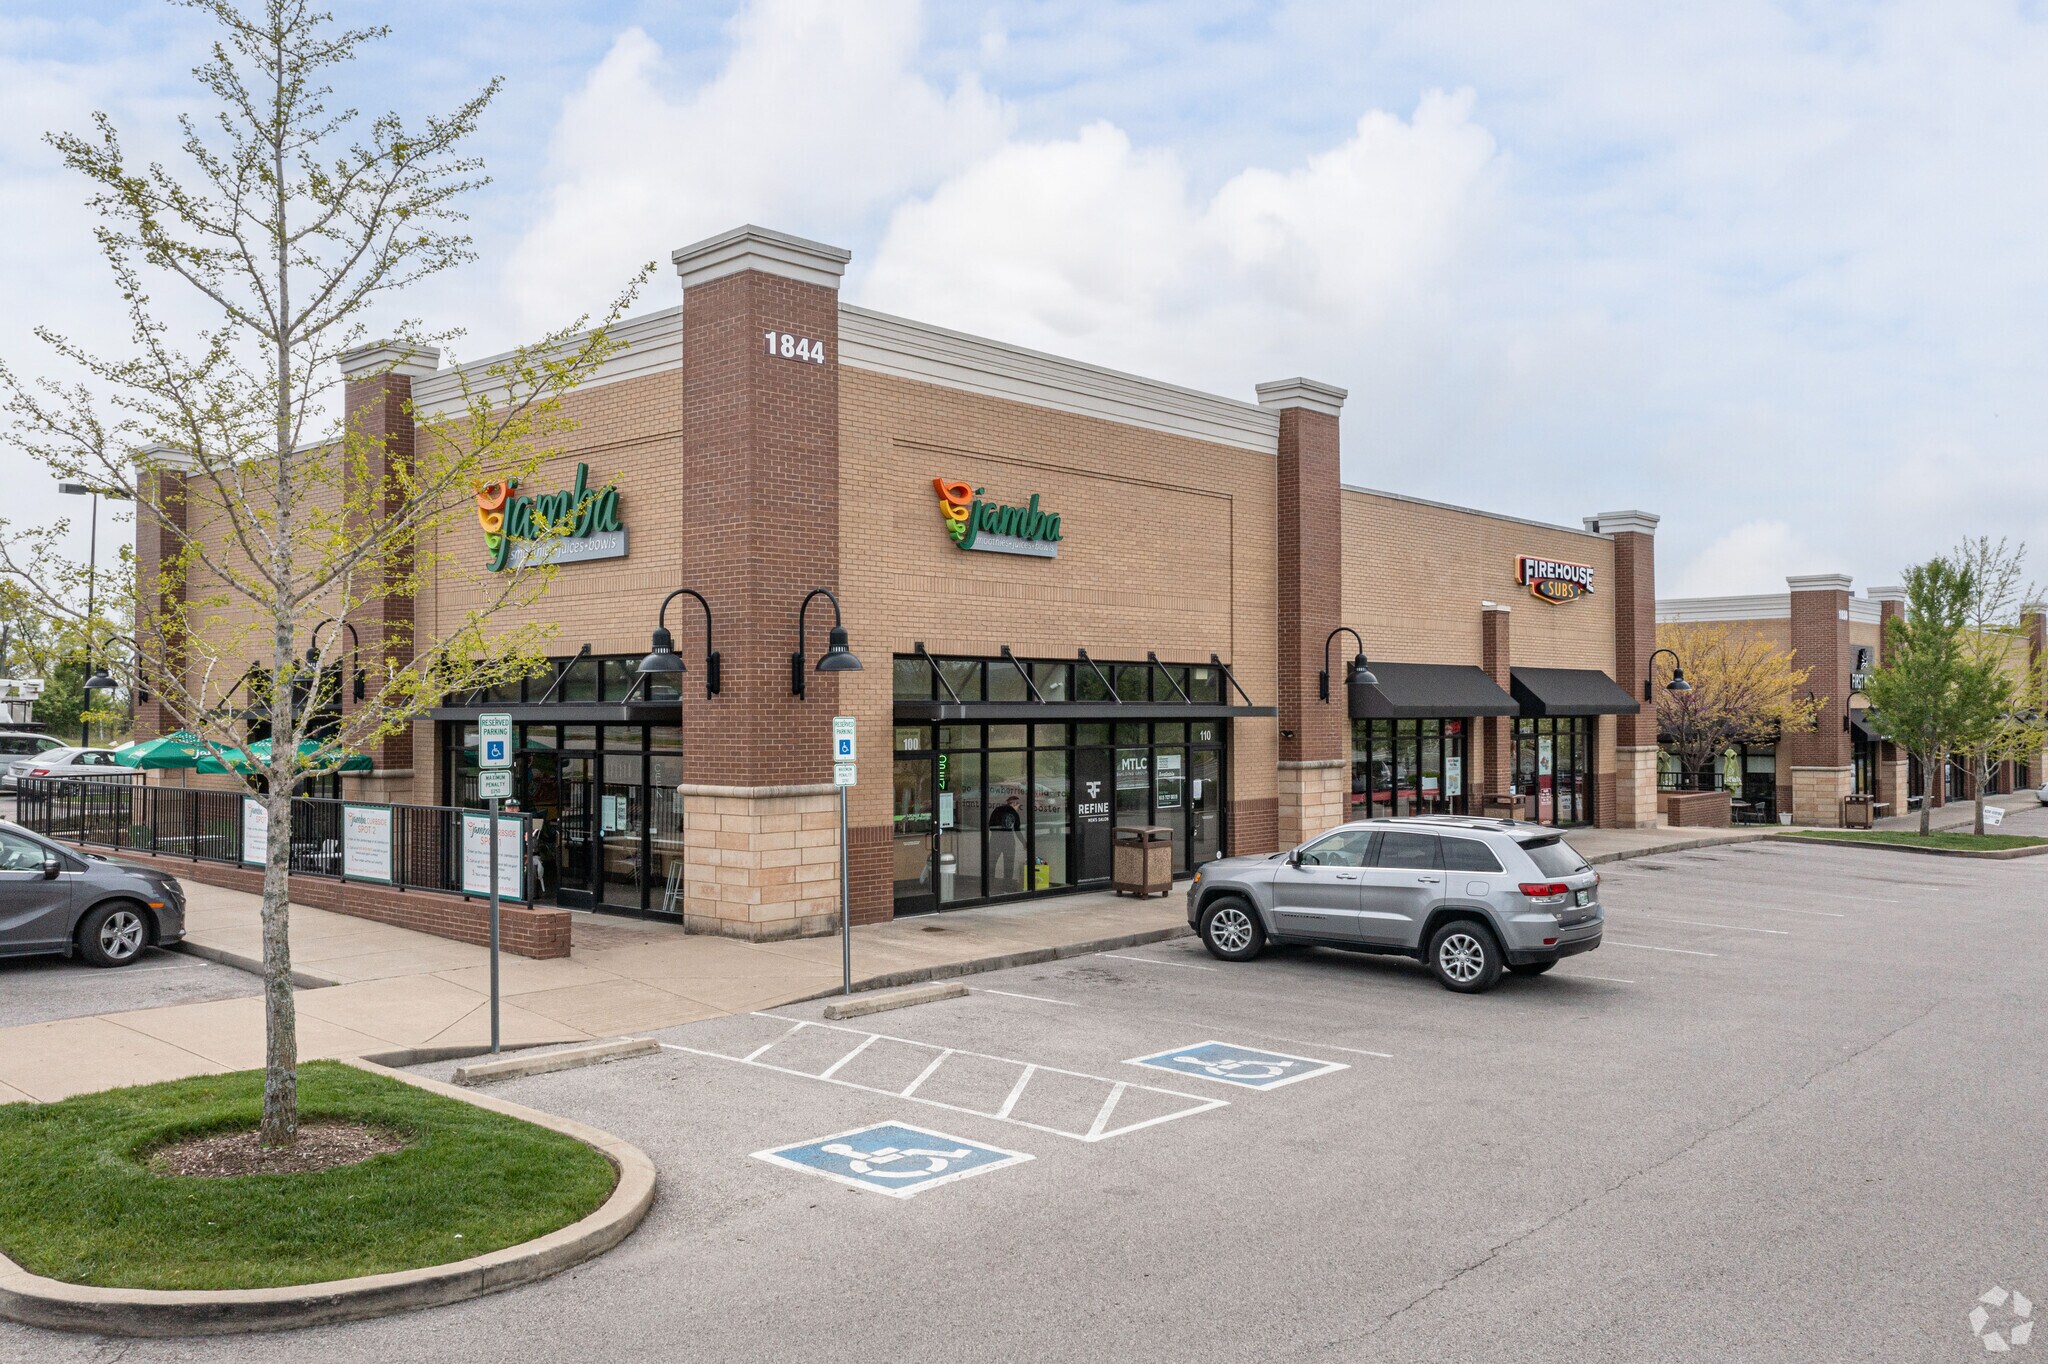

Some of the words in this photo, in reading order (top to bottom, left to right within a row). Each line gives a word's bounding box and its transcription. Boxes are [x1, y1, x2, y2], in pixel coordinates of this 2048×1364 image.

[765, 331, 825, 364] 1844
[486, 462, 623, 573] jamba
[956, 487, 1063, 550] jamba
[588, 535, 616, 551] bowls
[974, 536, 1009, 547] moothies
[1525, 558, 1594, 593] FIREHOUSE
[1548, 581, 1574, 597] SUBS
[481, 719, 509, 727] RESERVED
[483, 728, 508, 736] PARKING
[1200, 731, 1211, 741] 110
[903, 738, 919, 750] 100
[1121, 757, 1148, 770] MTLC
[1078, 802, 1109, 815] REFINE
[357, 825, 371, 834] SPOT
